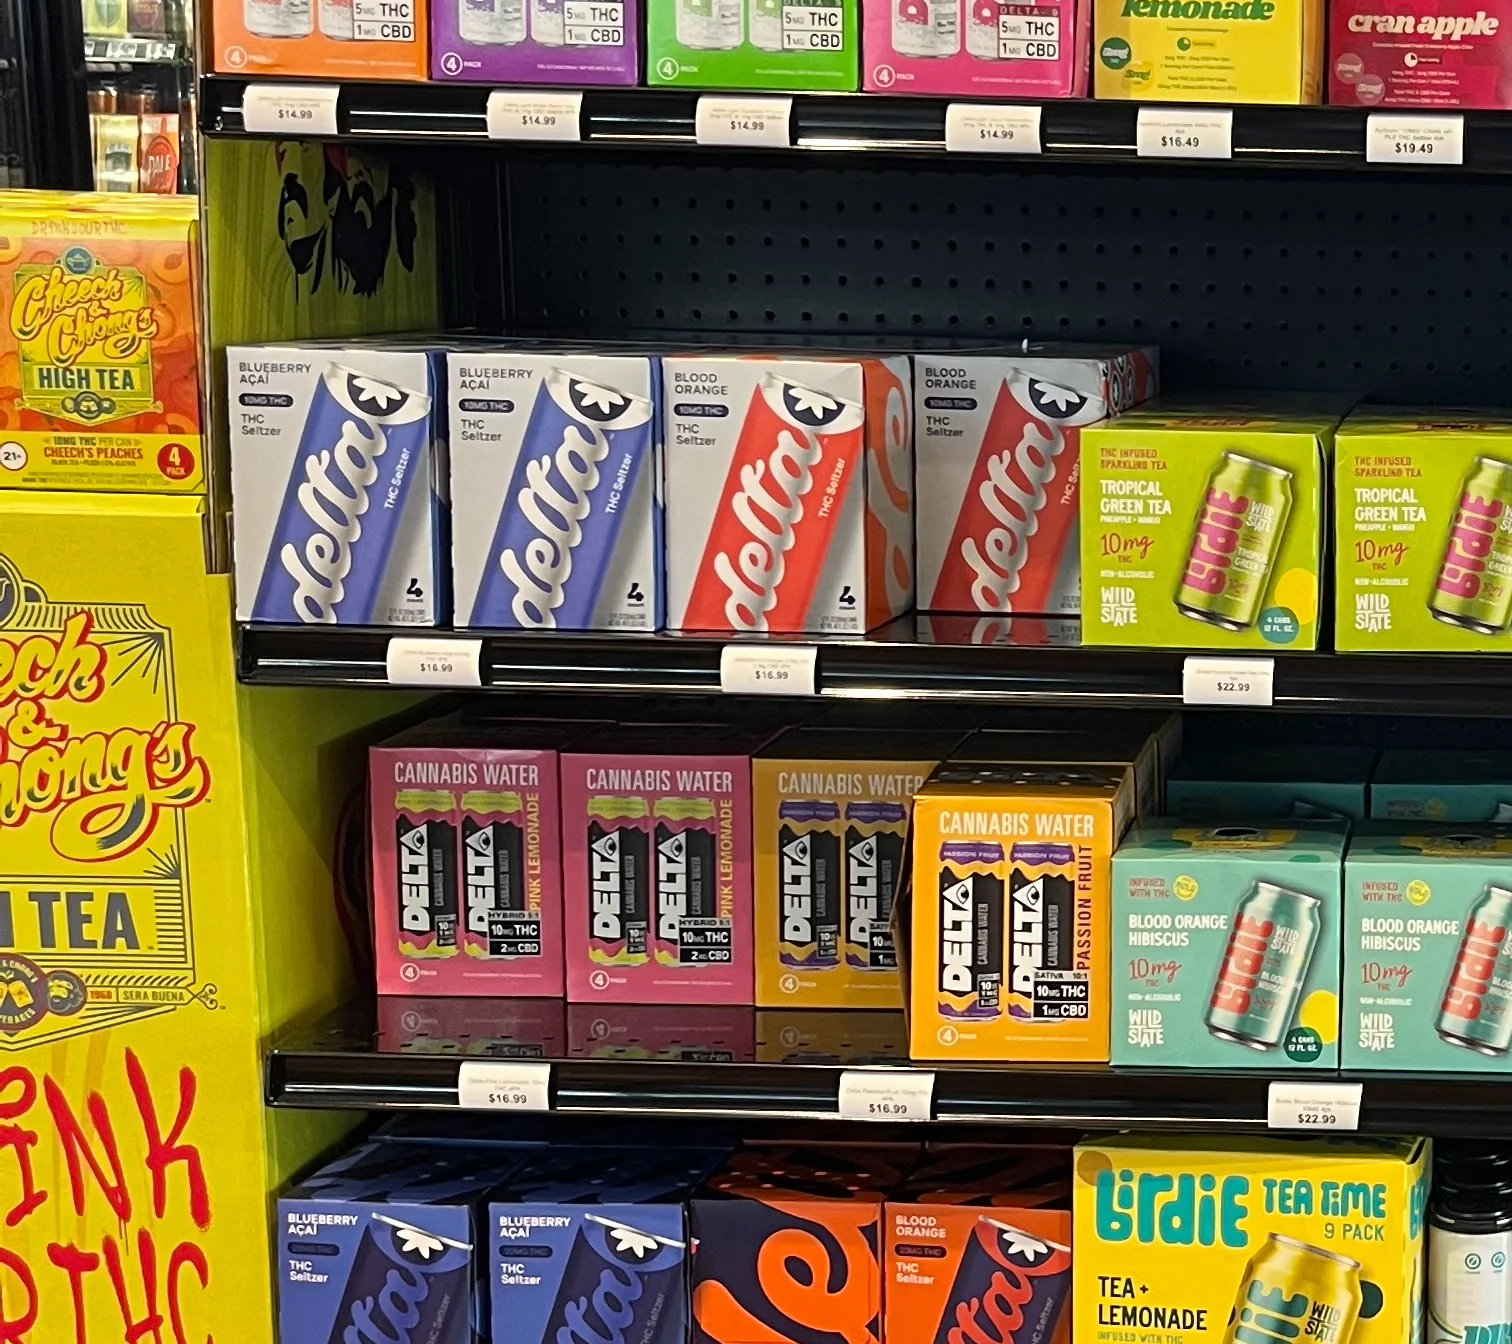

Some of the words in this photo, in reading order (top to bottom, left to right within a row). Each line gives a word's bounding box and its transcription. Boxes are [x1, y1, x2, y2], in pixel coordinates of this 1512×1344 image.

[1348, 12, 1415, 34] cran
[1420, 11, 1499, 41] apple
[278, 109, 313, 121] $14.99
[979, 129, 1015, 141] $14.99
[1161, 135, 1200, 149] $16.49
[1394, 142, 1434, 155] $19.49
[11, 266, 124, 341] Cheech
[39, 368, 90, 389] HIGH
[96, 369, 134, 390] TEA
[459, 367, 533, 379] BLUEBERRY
[674, 373, 717, 383] BLOOD
[674, 384, 728, 396] ORANGE
[460, 420, 485, 430] THC
[460, 431, 502, 442] Seltzer
[97, 448, 143, 459] PEACHES
[1100, 480, 1163, 495] TROPICAL
[1100, 498, 1144, 515] GREEN
[1148, 499, 1172, 515] TEA
[1101, 587, 1136, 605] WILD
[1101, 605, 1137, 627] STATE
[394, 762, 477, 784] CANNABIS
[483, 764, 539, 786] WATER
[526, 792, 540, 872] LEMONADE
[1078, 845, 1093, 894] FRUIT
[527, 875, 540, 913] PINK
[1128, 914, 1172, 929] BLOOD
[1175, 914, 1228, 930] ORANGE
[1077, 898, 1092, 971] PASSION
[1128, 932, 1189, 947] HIBISCUS
[489, 1093, 527, 1104] $16.99
[1297, 1114, 1336, 1125] $22.99
[1263, 1179, 1313, 1214] TEA
[1324, 1223, 1335, 1239] 9
[1342, 1224, 1385, 1241] PACK
[1098, 1276, 1135, 1298] TEA
[1098, 1305, 1207, 1332] LEMONADE
